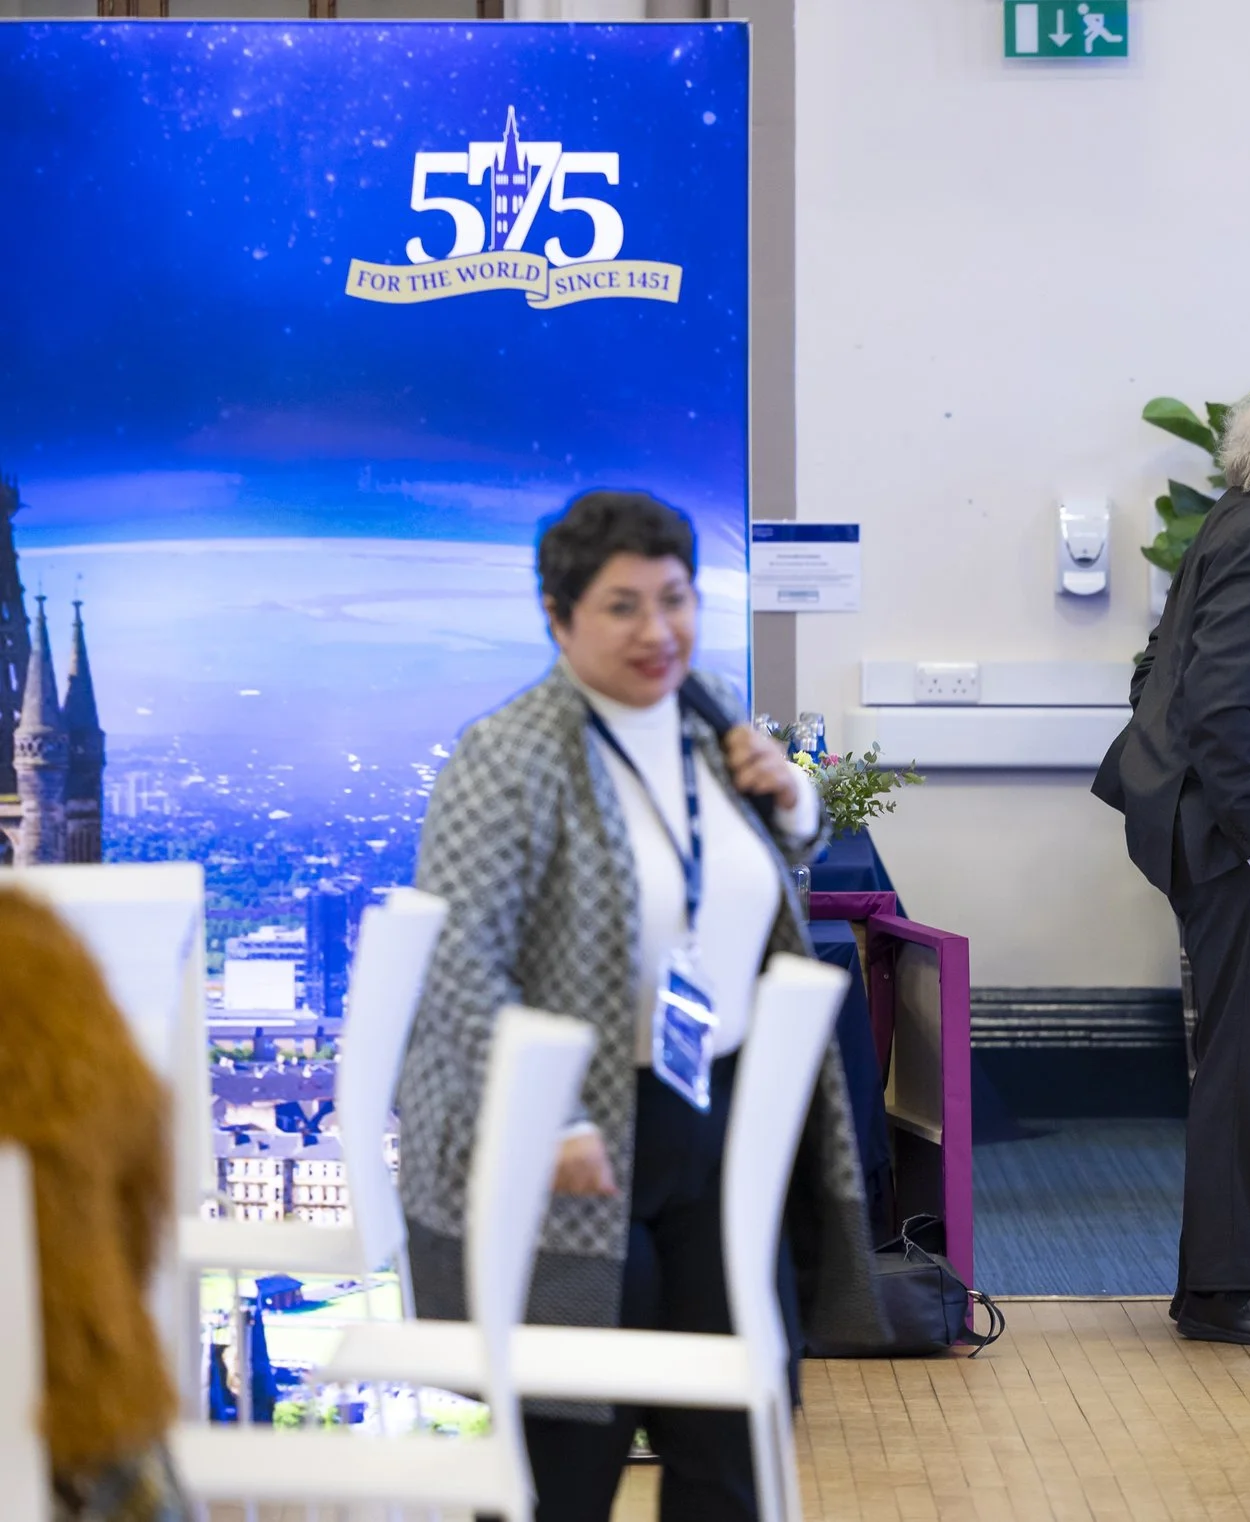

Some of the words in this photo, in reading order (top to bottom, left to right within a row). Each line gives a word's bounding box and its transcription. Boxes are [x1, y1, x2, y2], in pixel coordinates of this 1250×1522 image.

[405, 142, 624, 267] 575
[357, 270, 400, 293] FOR
[407, 269, 452, 292] THE
[456, 261, 540, 283] WORLD
[555, 271, 620, 295] SINCE
[627, 271, 670, 291] 1451
